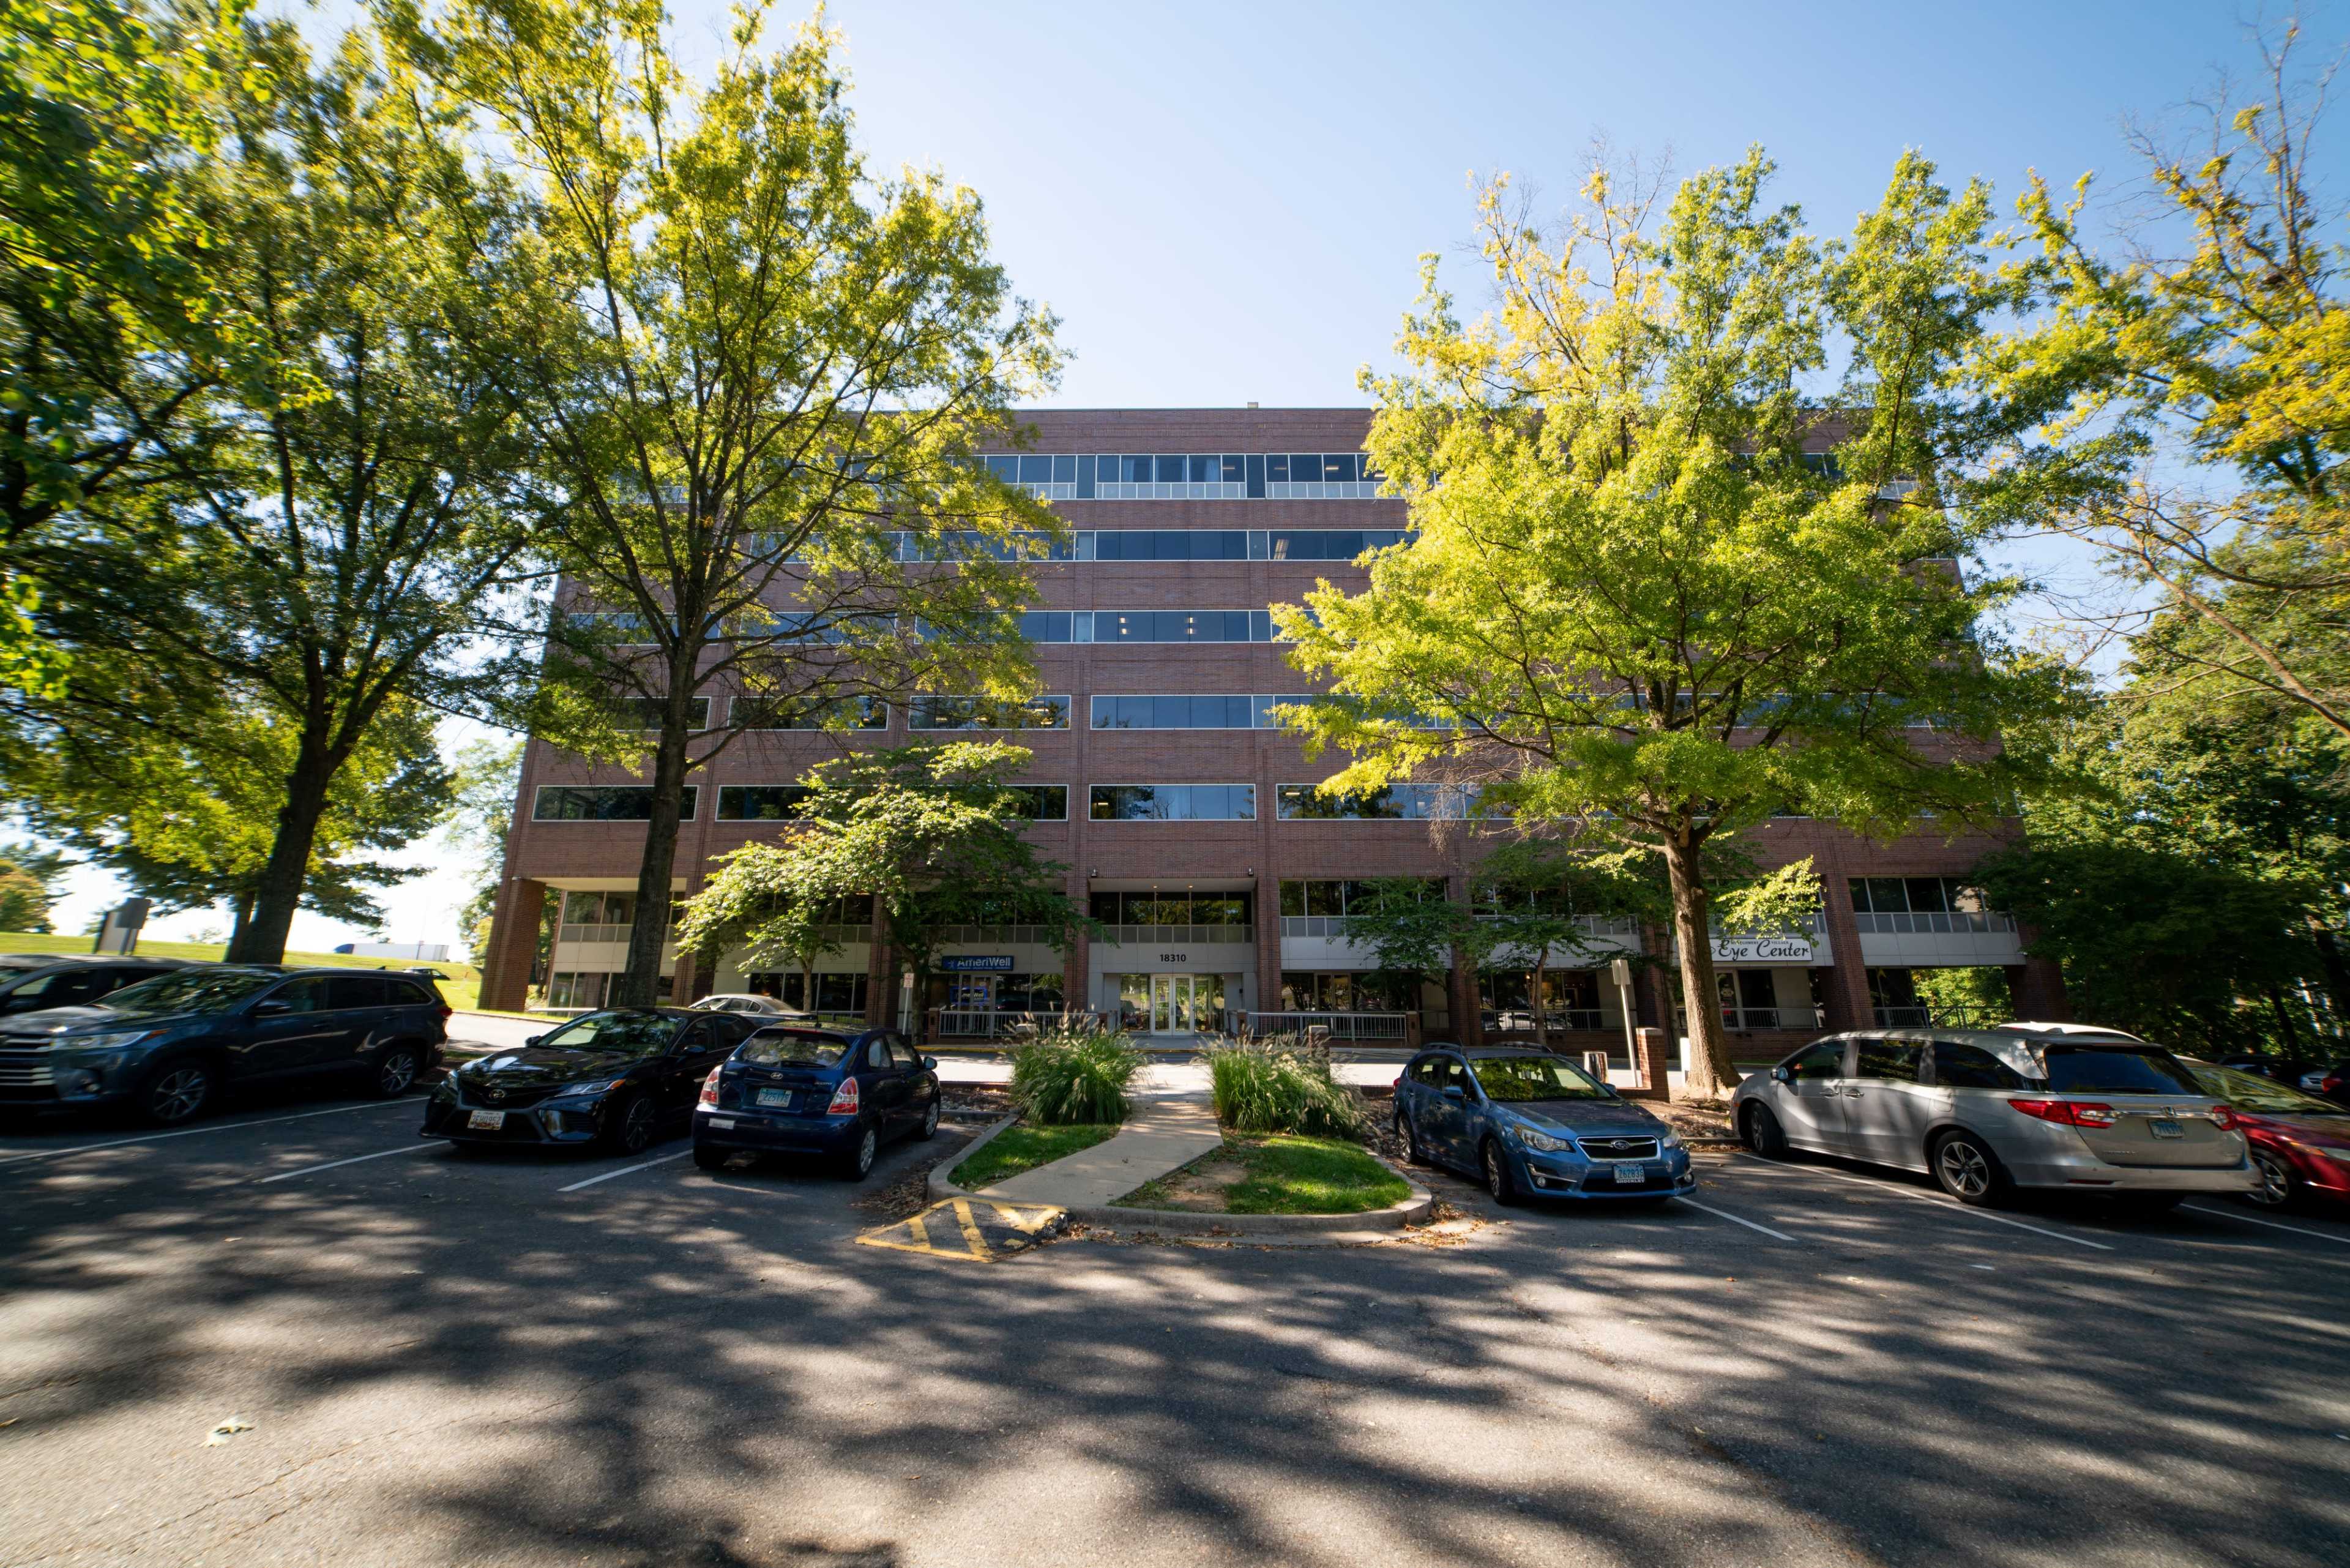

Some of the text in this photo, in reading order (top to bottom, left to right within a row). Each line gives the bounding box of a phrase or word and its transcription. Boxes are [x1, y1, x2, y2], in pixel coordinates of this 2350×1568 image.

[1718, 939, 1810, 960] Eye Center
[957, 957, 1011, 967] AmeriWell
